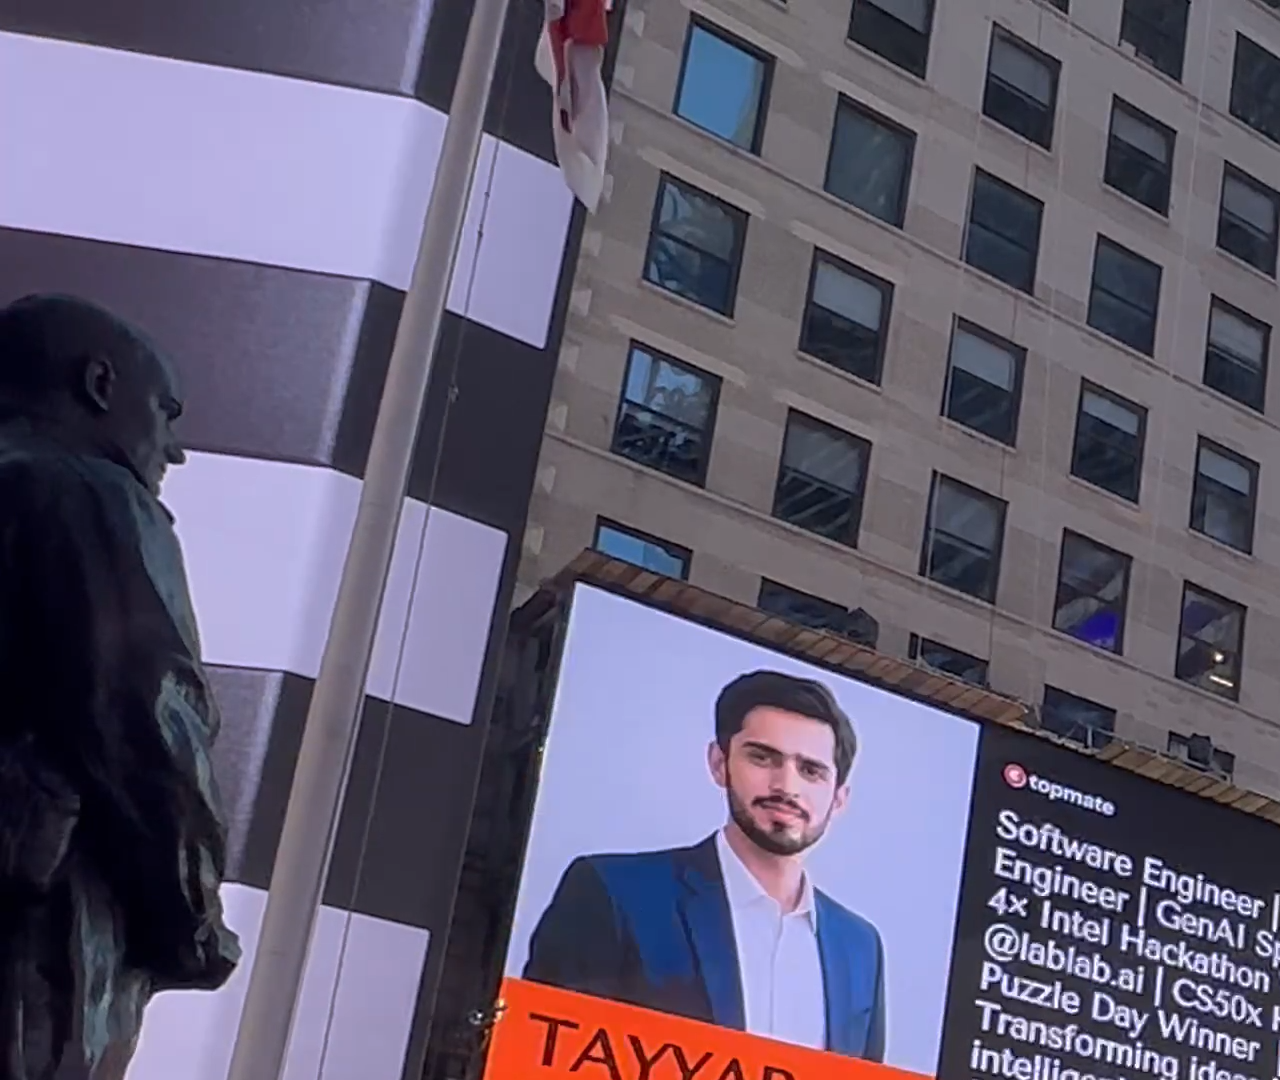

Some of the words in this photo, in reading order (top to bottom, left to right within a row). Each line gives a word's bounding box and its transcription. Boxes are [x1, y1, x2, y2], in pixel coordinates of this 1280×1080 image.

[1029, 773, 1117, 817] topmate
[993, 847, 1130, 914] Engineer
[1155, 900, 1245, 950] GenAI
[997, 810, 1134, 878] Software
[1142, 857, 1266, 920] Engineer
[983, 923, 1145, 996] @lablab.ai
[1172, 977, 1264, 1029] CS50x
[1039, 900, 1110, 948] Intel
[1120, 924, 1271, 995] Hackathon
[979, 967, 1081, 1017] Puzzle
[1090, 990, 1150, 1039] Day
[1156, 1008, 1262, 1063] Winner
